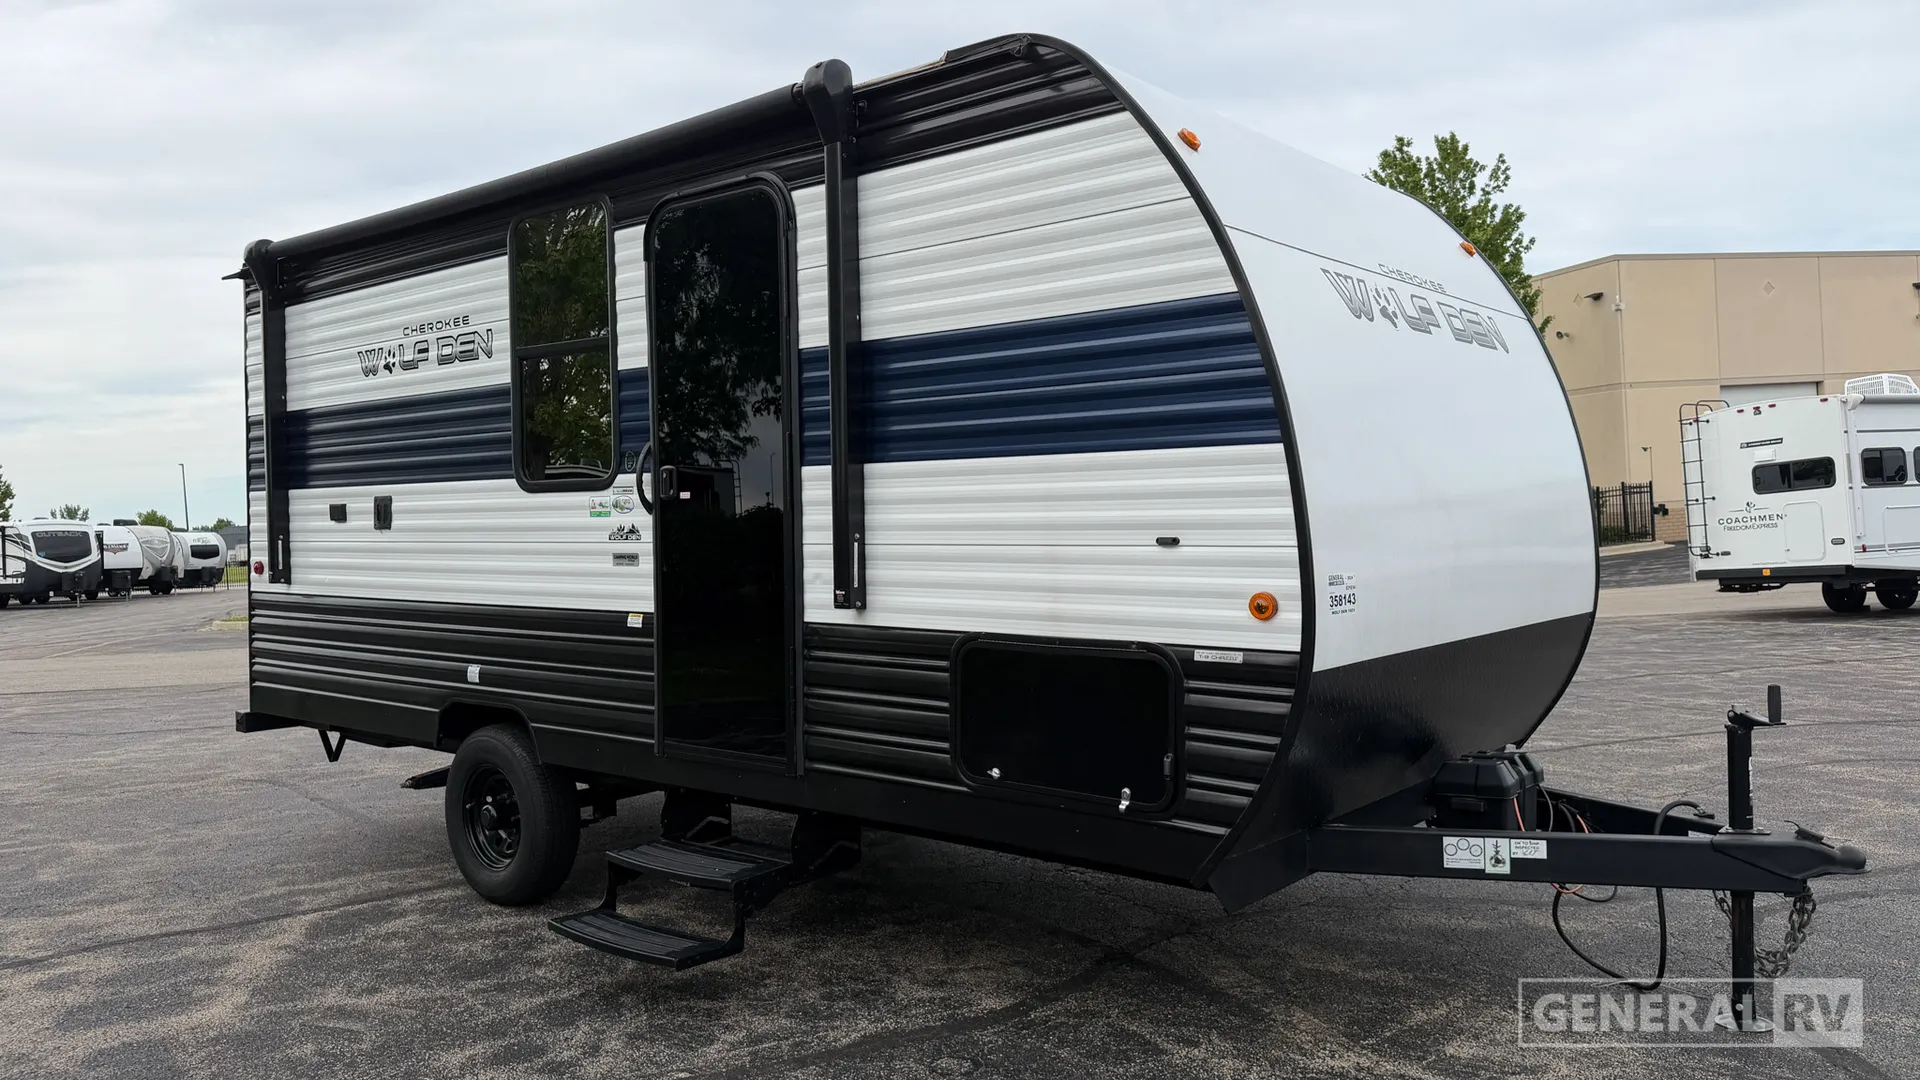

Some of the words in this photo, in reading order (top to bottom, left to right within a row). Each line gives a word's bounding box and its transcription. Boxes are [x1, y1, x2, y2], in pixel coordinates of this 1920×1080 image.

[1378, 263, 1447, 293] CHEROKEE
[402, 315, 470, 336] CHEROKEE
[1436, 301, 1509, 354] DEN
[436, 328, 493, 366] DEN
[1717, 513, 1783, 525] COACHMEN
[1329, 593, 1356, 607] 358143
